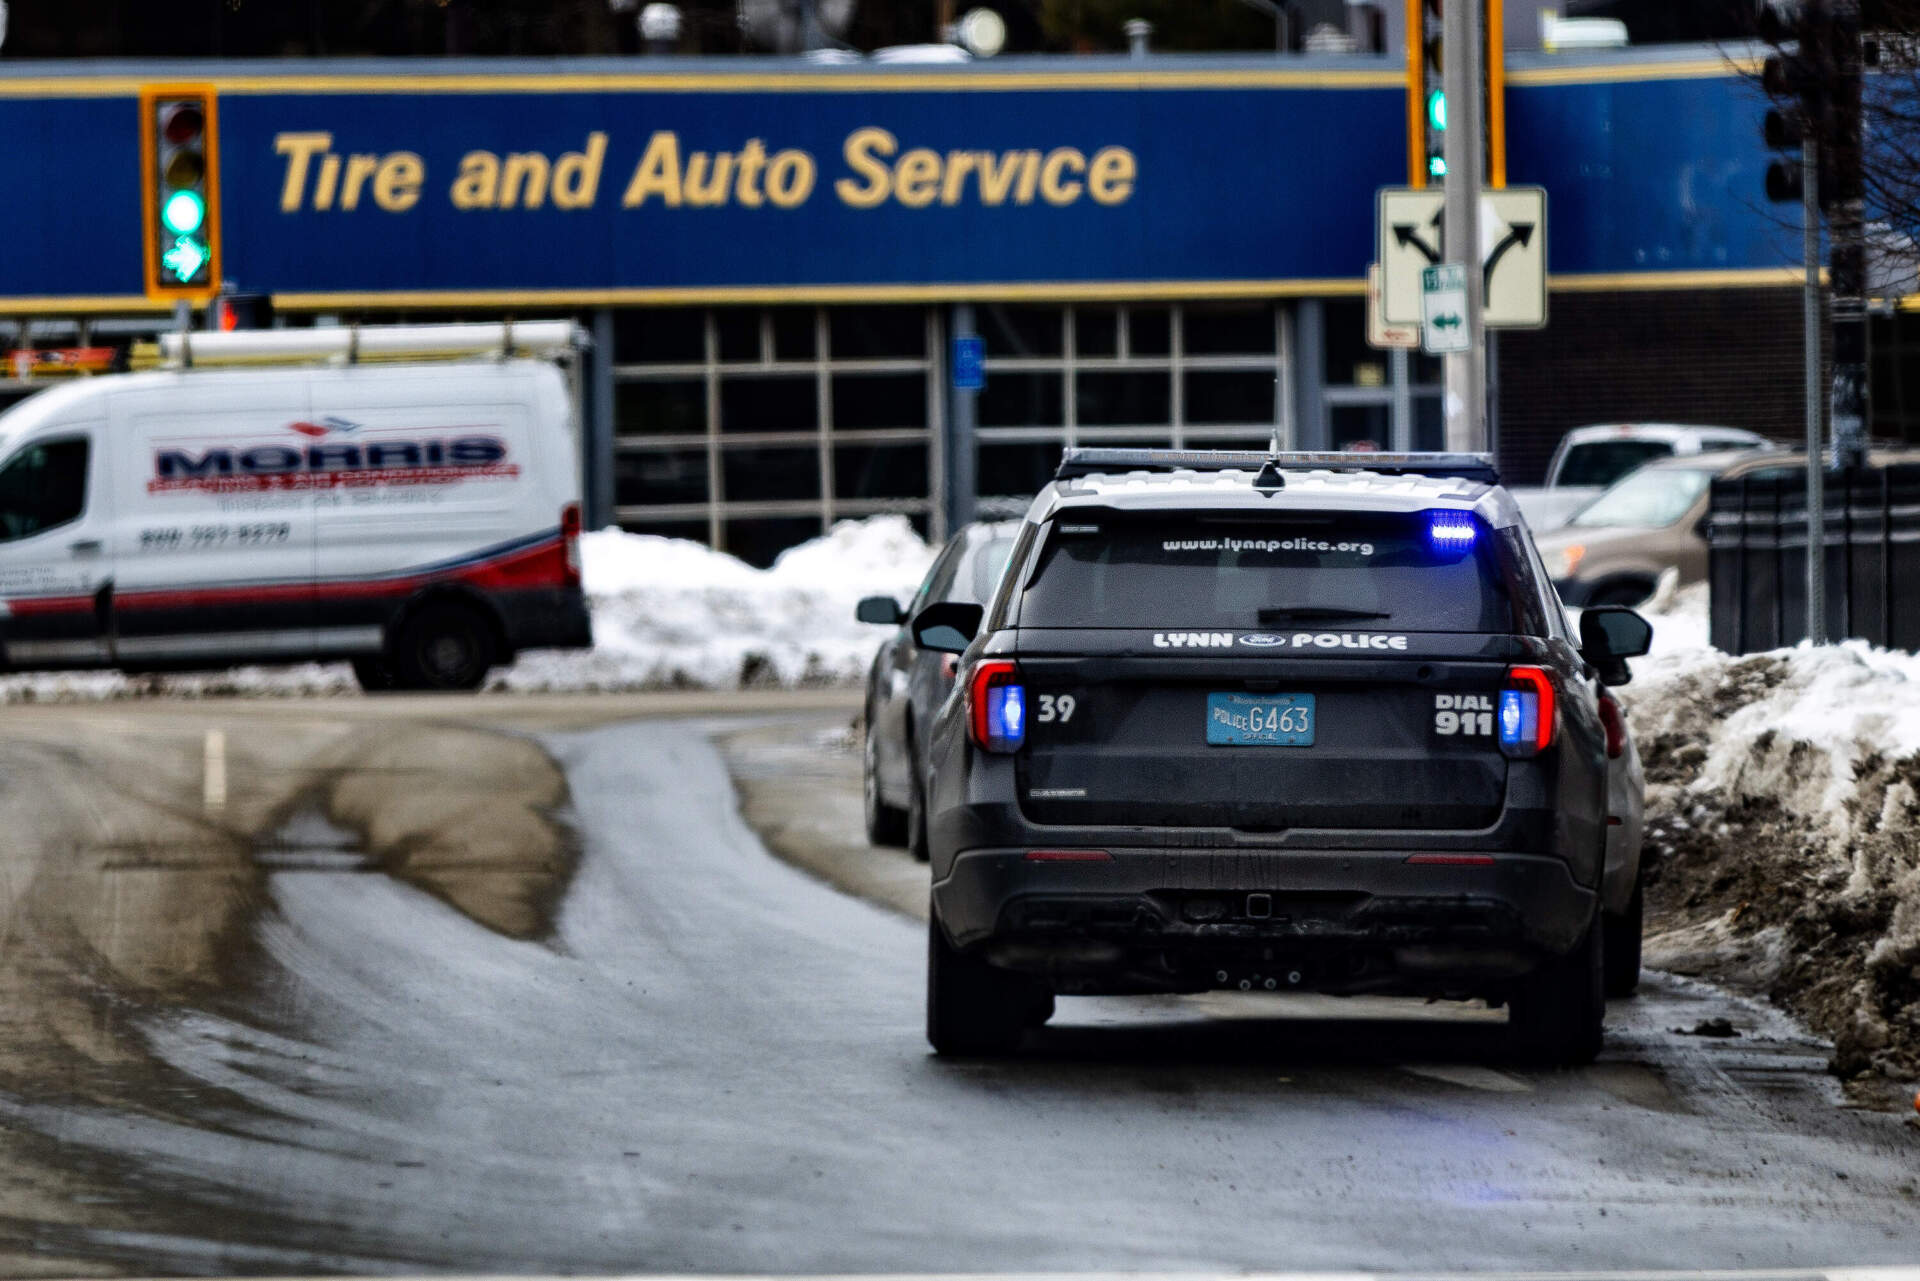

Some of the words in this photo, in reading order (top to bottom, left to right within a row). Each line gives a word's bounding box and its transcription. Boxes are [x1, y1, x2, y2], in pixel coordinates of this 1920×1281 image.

[274, 131, 427, 214] Tire
[449, 129, 609, 211] and
[621, 130, 817, 209] Auto
[834, 126, 1139, 210] Service
[156, 438, 507, 478] MORRIS
[1163, 537, 1375, 556] www.lynnpolice.org
[1152, 633, 1234, 648] LYNN
[1291, 634, 1408, 650] POLICE
[1038, 694, 1076, 722] 39
[1435, 694, 1493, 710] DIAL
[1213, 706, 1248, 731] POLICE
[1249, 706, 1310, 733] G463
[1435, 711, 1493, 736] 911
